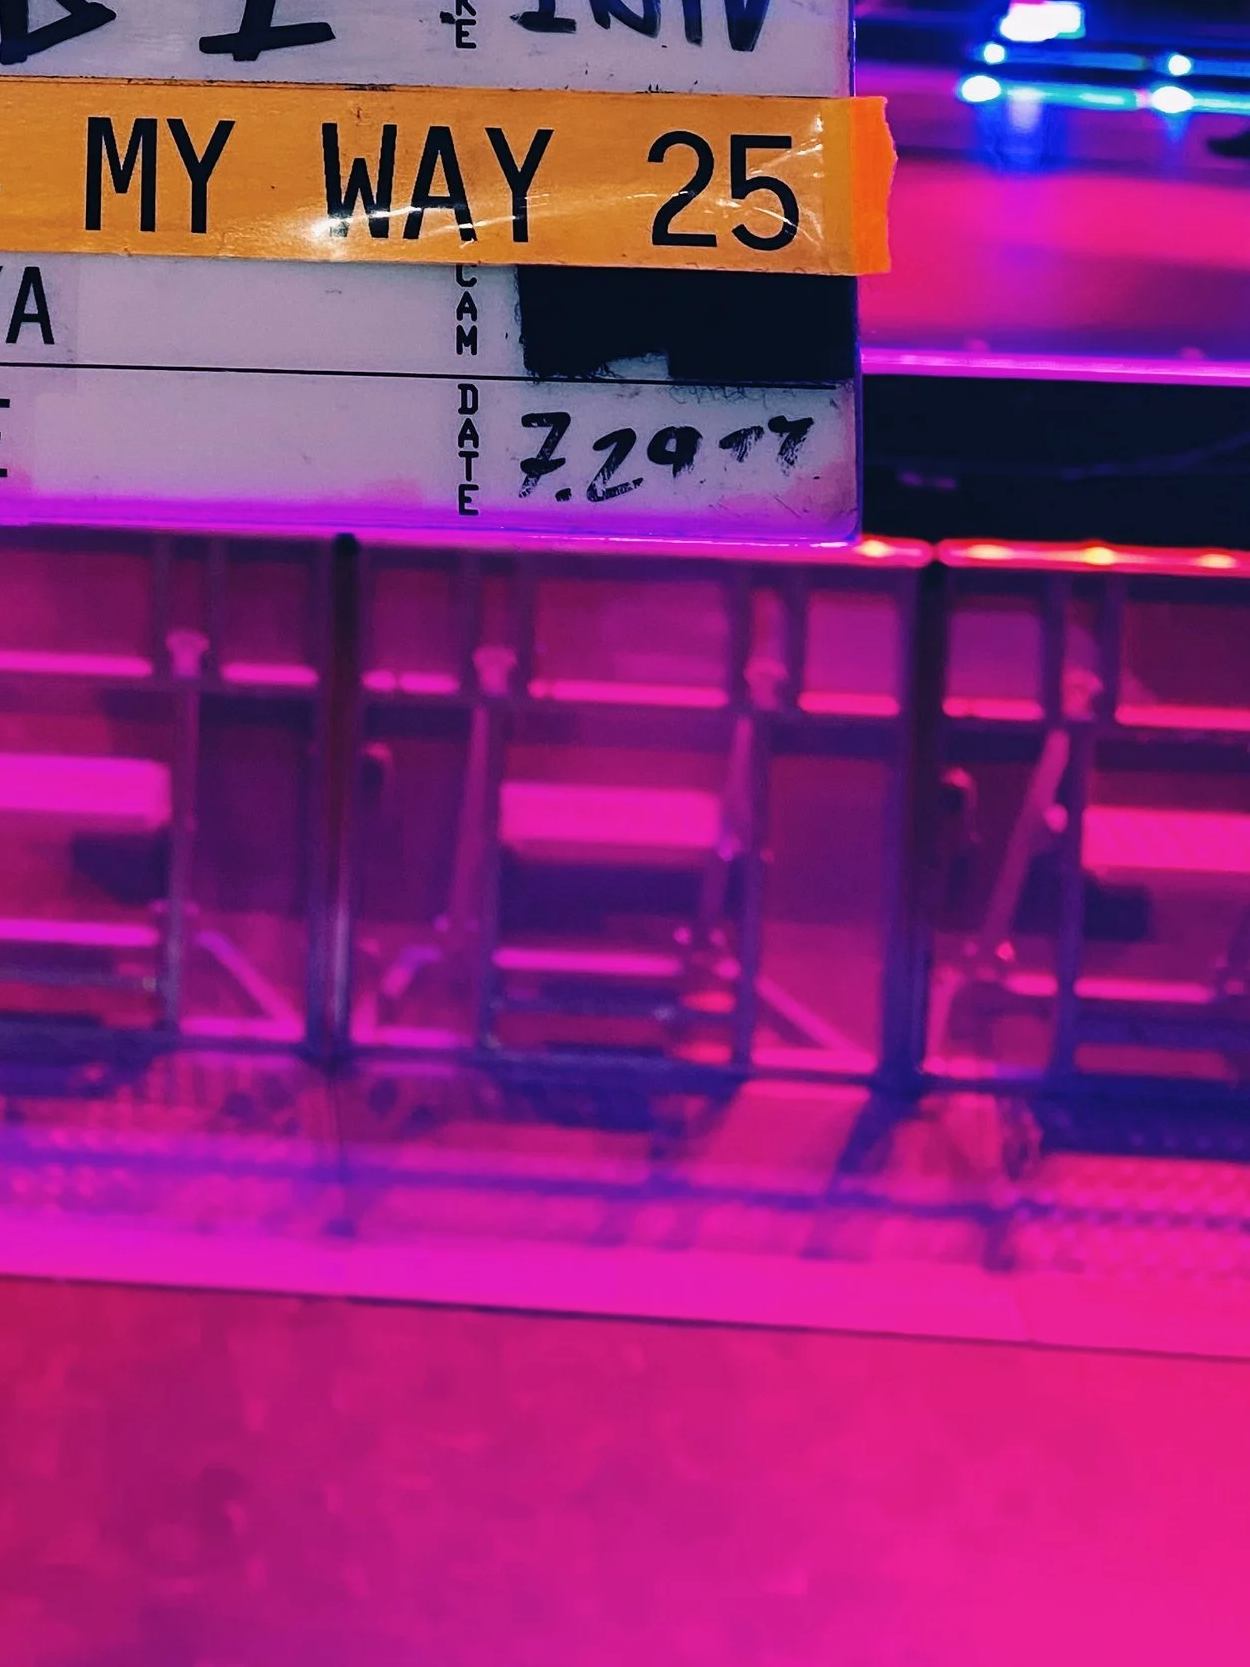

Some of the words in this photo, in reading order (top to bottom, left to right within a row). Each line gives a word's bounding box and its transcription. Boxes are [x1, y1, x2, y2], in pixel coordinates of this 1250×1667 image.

[85, 116, 236, 234] MY
[321, 122, 554, 243] WAY
[647, 130, 800, 251] 25
[457, 383, 480, 516] DATE
